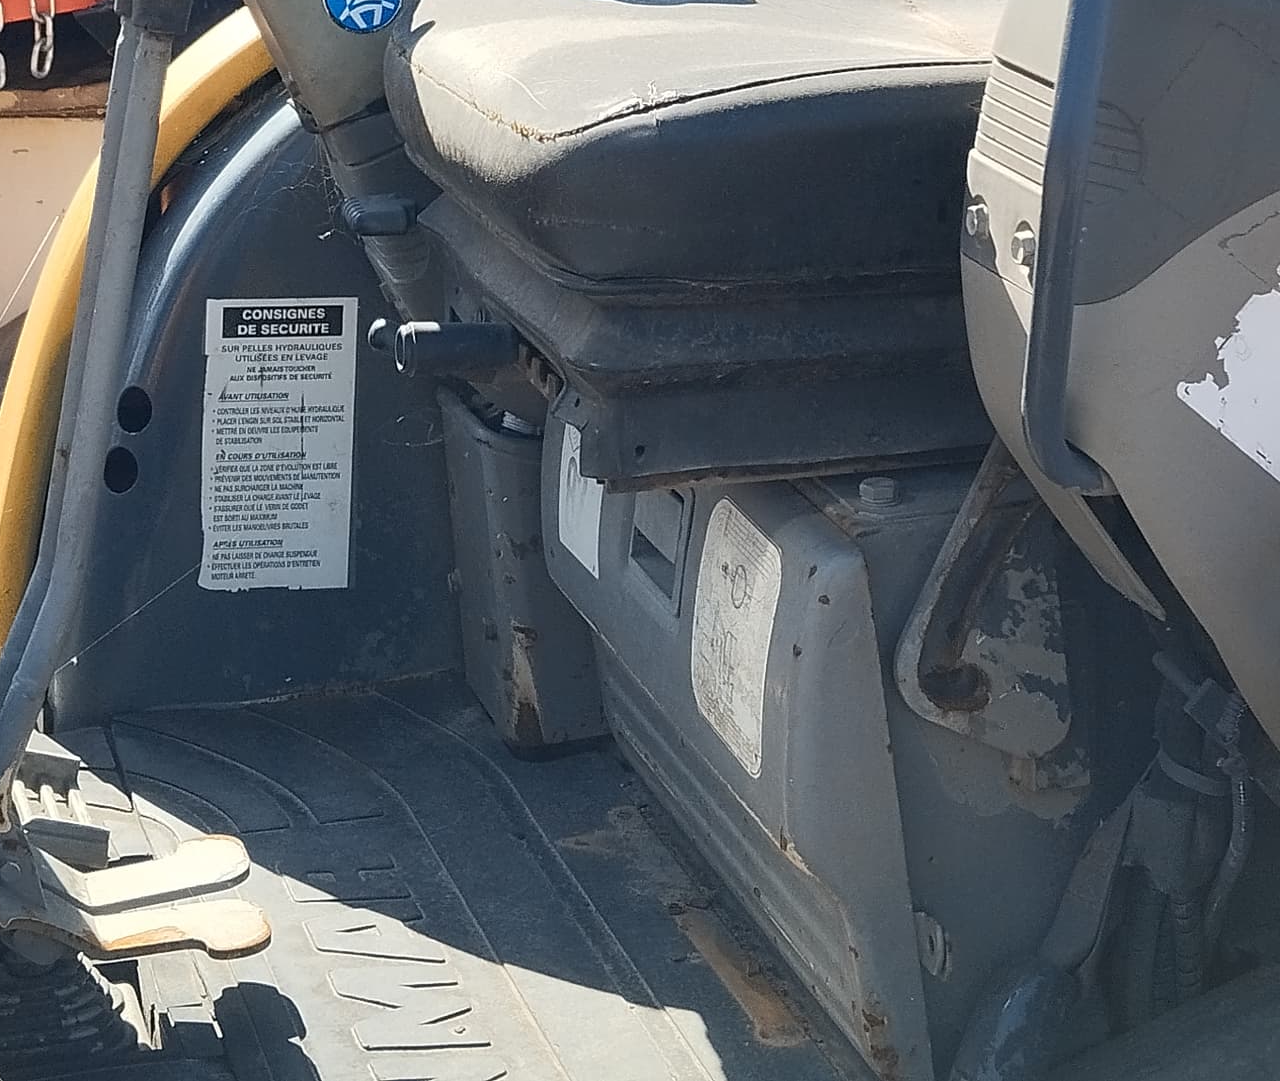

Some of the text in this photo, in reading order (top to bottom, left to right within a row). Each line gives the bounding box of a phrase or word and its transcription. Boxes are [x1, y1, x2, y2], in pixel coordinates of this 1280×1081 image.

[242, 308, 326, 320] CONSIGNES
[237, 323, 330, 336] DE SECURITE
[221, 342, 343, 353] SUR PELLES HYDRAULIQUES
[281, 353, 293, 361] EN
[295, 352, 329, 361] LEVAGE
[218, 392, 290, 400] AVANT UTILISATION
[227, 452, 252, 460] COURS
[239, 539, 284, 547] UTILISATION
